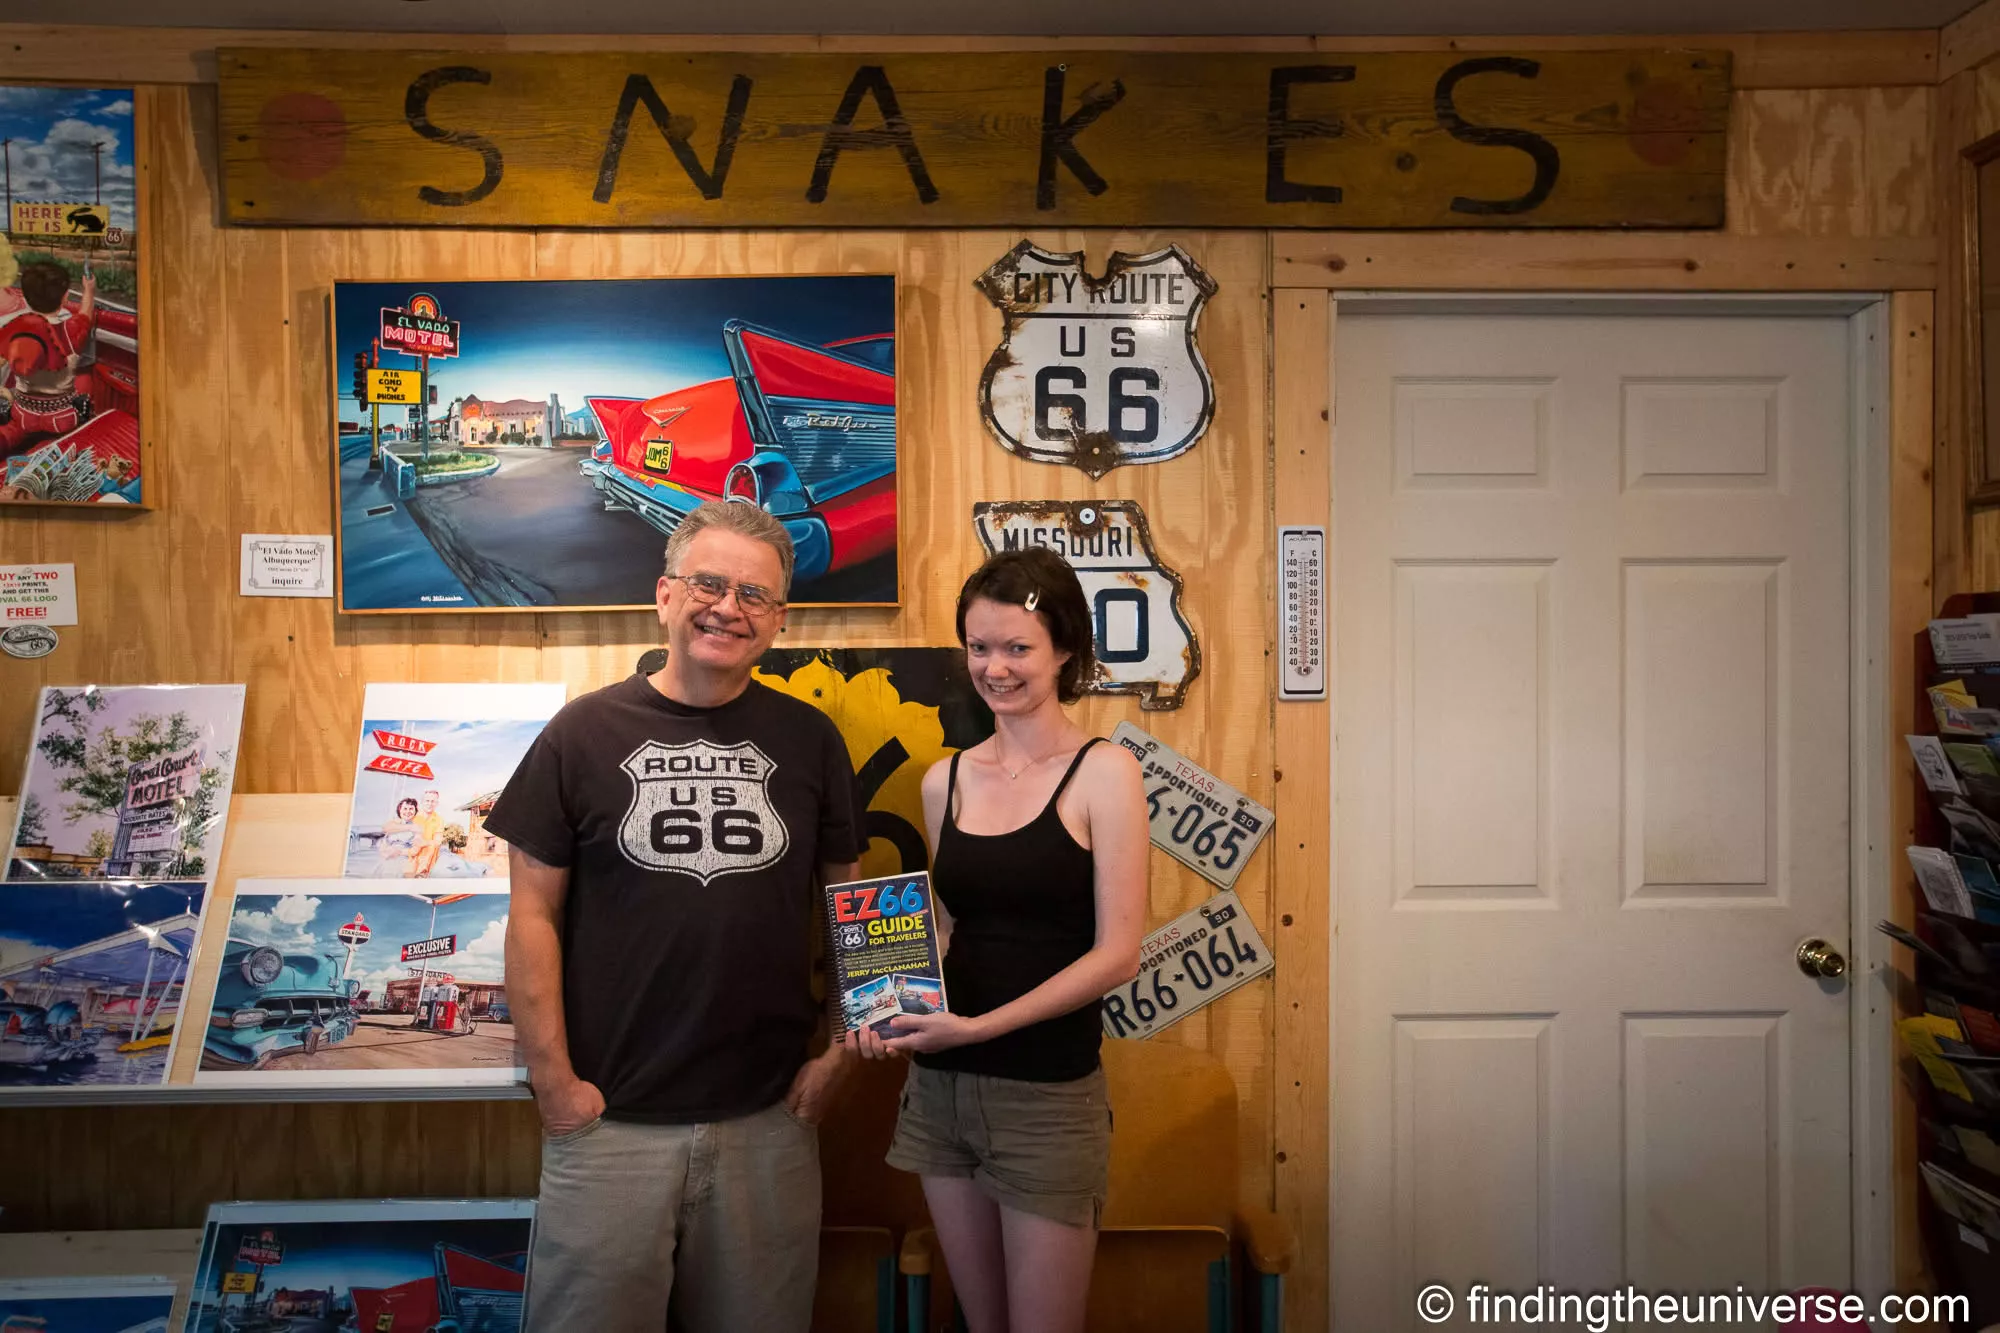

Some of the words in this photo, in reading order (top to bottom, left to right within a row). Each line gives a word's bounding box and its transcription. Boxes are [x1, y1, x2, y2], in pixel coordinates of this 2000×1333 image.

[403, 57, 1561, 214] SNAKES
[18, 207, 62, 219] HERE
[18, 221, 36, 233] IT
[44, 220, 61, 233] IS
[108, 234, 120, 243] 66
[1014, 272, 1079, 304] CITY
[398, 316, 413, 328] EL
[417, 320, 450, 333] VADO
[384, 325, 455, 348] MOTEL
[378, 378, 402, 386] COND
[382, 371, 400, 379] AIR
[376, 393, 406, 401] PHONES
[1034, 366, 1161, 444] 66
[1003, 527, 1133, 558] MISSOURI
[33, 571, 58, 580] TWO
[272, 576, 304, 587] inquire
[6, 607, 48, 617] FREE!
[387, 735, 426, 753] ROCK
[380, 757, 423, 773] CAFE
[644, 756, 758, 775] ROUTE
[1175, 761, 1215, 793] TEXAS
[131, 776, 186, 805] MOTEL
[1146, 761, 1229, 818] APPORTIONED
[1239, 814, 1255, 828] 90
[650, 808, 764, 855] 66
[834, 882, 924, 923] EZ66
[867, 914, 925, 936] GUIDE
[1214, 910, 1231, 924] 90
[341, 929, 370, 938] STANDARD
[845, 933, 862, 946] 66
[868, 937, 886, 946] FOR
[887, 931, 927, 944] TRAVELERS
[408, 937, 451, 956] EXCLUSIVE
[1140, 927, 1182, 957] TEXAS
[847, 969, 870, 979] JERRY
